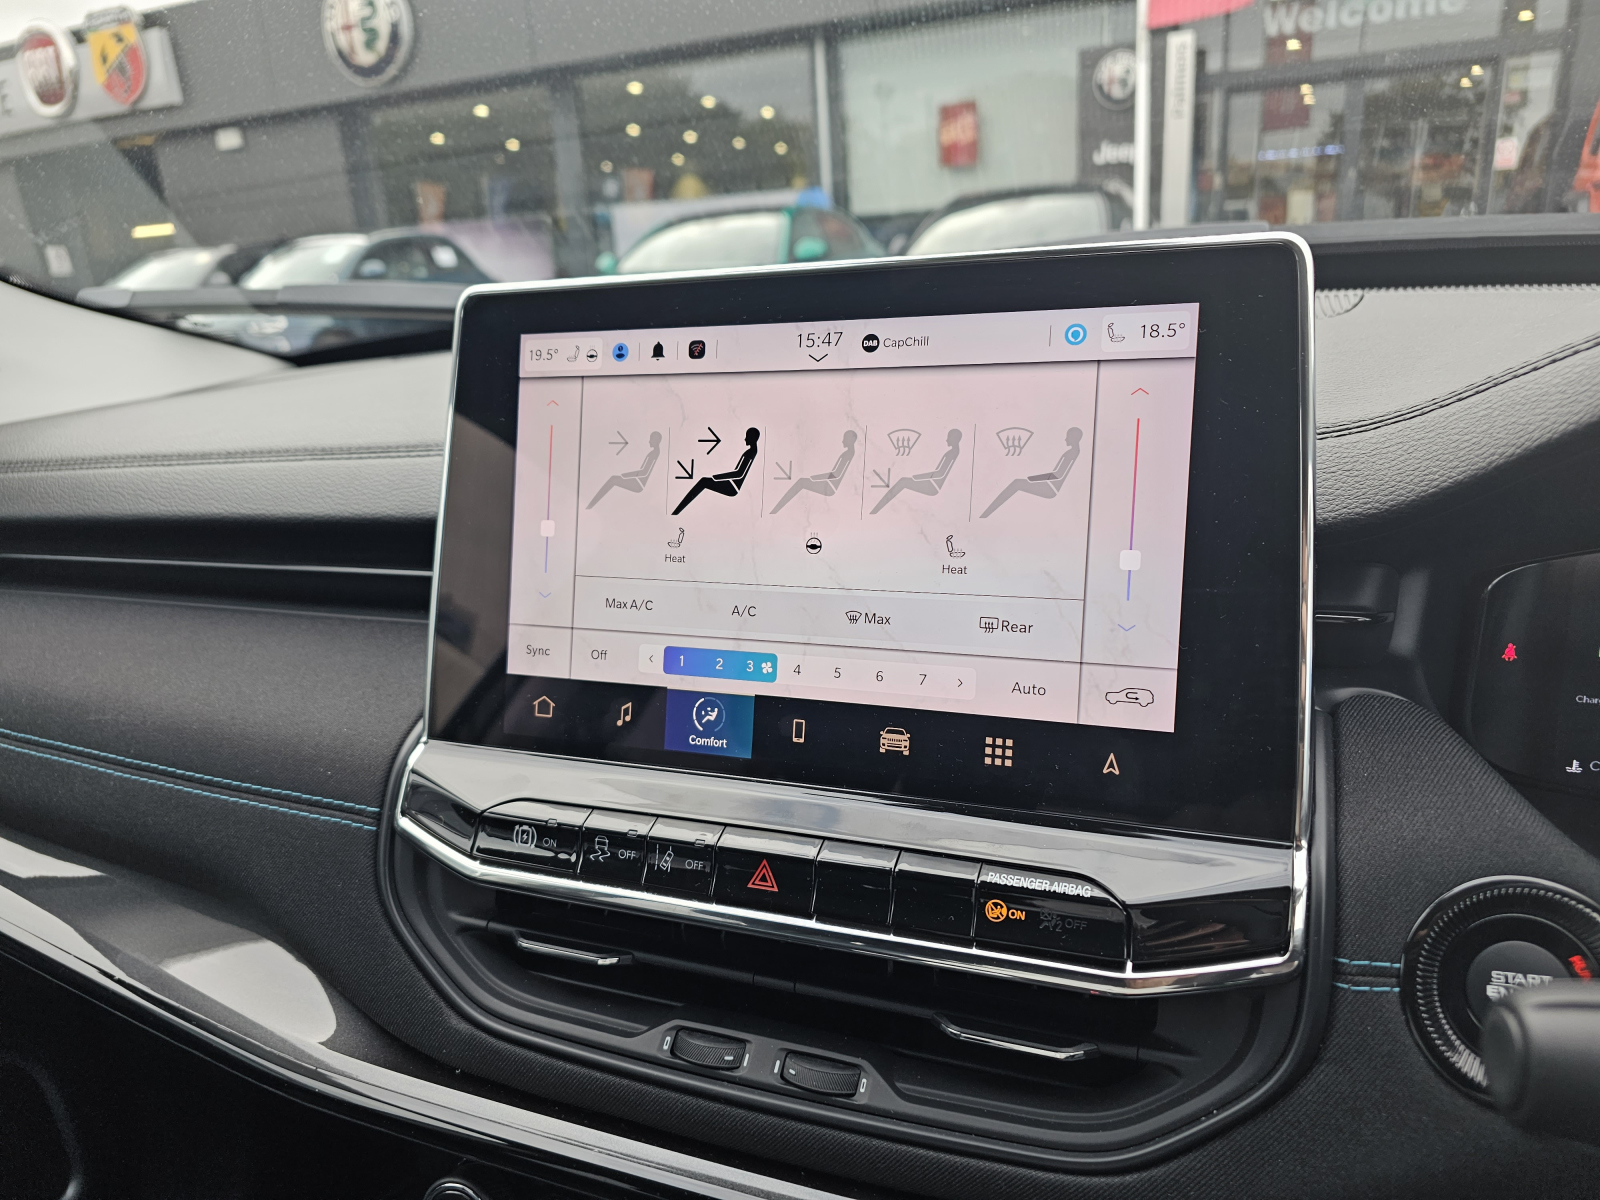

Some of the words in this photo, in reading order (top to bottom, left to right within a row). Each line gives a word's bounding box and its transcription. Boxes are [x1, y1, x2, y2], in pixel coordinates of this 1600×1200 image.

[1263, 0, 1466, 36] Welcome
[1140, 322, 1186, 339] 18.5°
[797, 331, 843, 348] 15:47
[883, 336, 930, 350] CapChill
[529, 348, 559, 362] 19.5°
[664, 553, 686, 564] Heat
[941, 564, 968, 575] Heat
[605, 598, 628, 610] Max
[630, 599, 653, 611] A/C
[731, 604, 757, 618] A/C
[864, 612, 891, 625] Max
[1001, 619, 1034, 634] Rear
[526, 644, 551, 657] Sync
[591, 649, 608, 661] Off
[679, 655, 685, 667] 1
[715, 658, 724, 670] 2
[746, 660, 754, 672] 3
[793, 664, 802, 676] 4
[833, 667, 842, 679] 5
[875, 670, 884, 682] 6
[919, 673, 928, 686] 7
[1011, 681, 1047, 696] Auto
[688, 734, 727, 748] Comfort
[542, 837, 557, 848] ON
[618, 849, 636, 861] OFF
[685, 859, 704, 871] OFF
[987, 872, 1050, 891] PASSENGER
[1050, 881, 1092, 898] AIRBAG
[1008, 909, 1026, 921] ON
